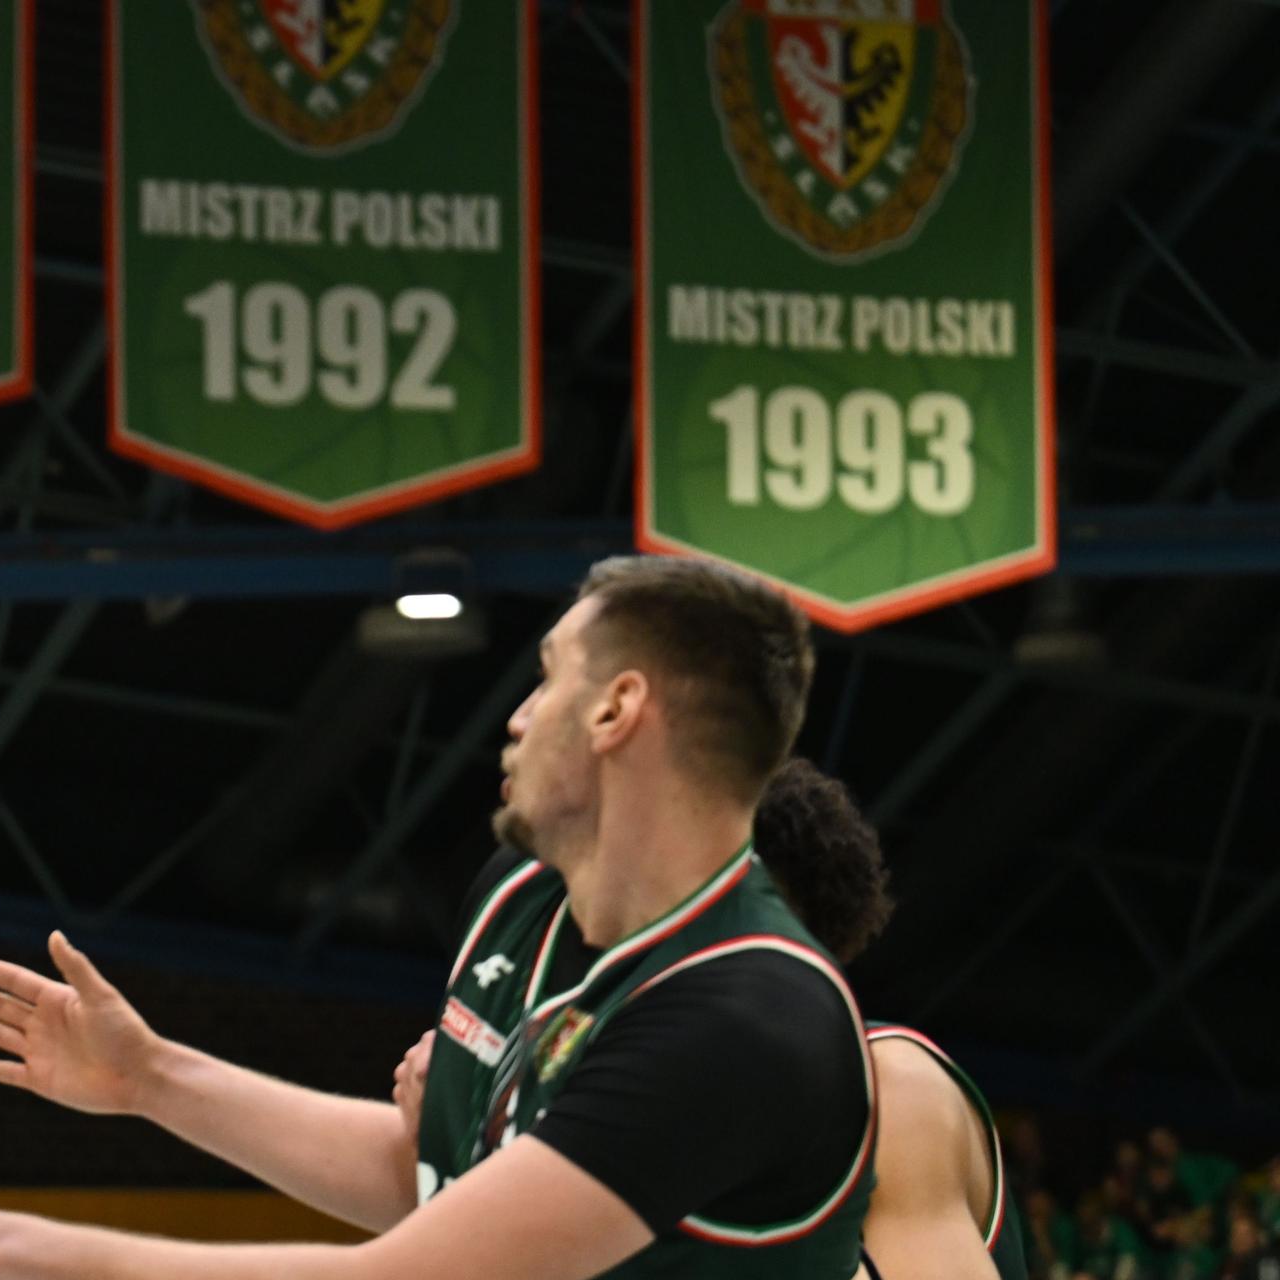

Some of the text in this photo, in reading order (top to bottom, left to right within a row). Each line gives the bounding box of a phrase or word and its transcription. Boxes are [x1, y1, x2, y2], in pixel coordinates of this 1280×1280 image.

[140, 178, 502, 252] MISTRZ POLSKI
[184, 279, 457, 411] 1992
[668, 284, 1016, 359] MISTRZ POLSKI
[709, 385, 975, 517] 1993
